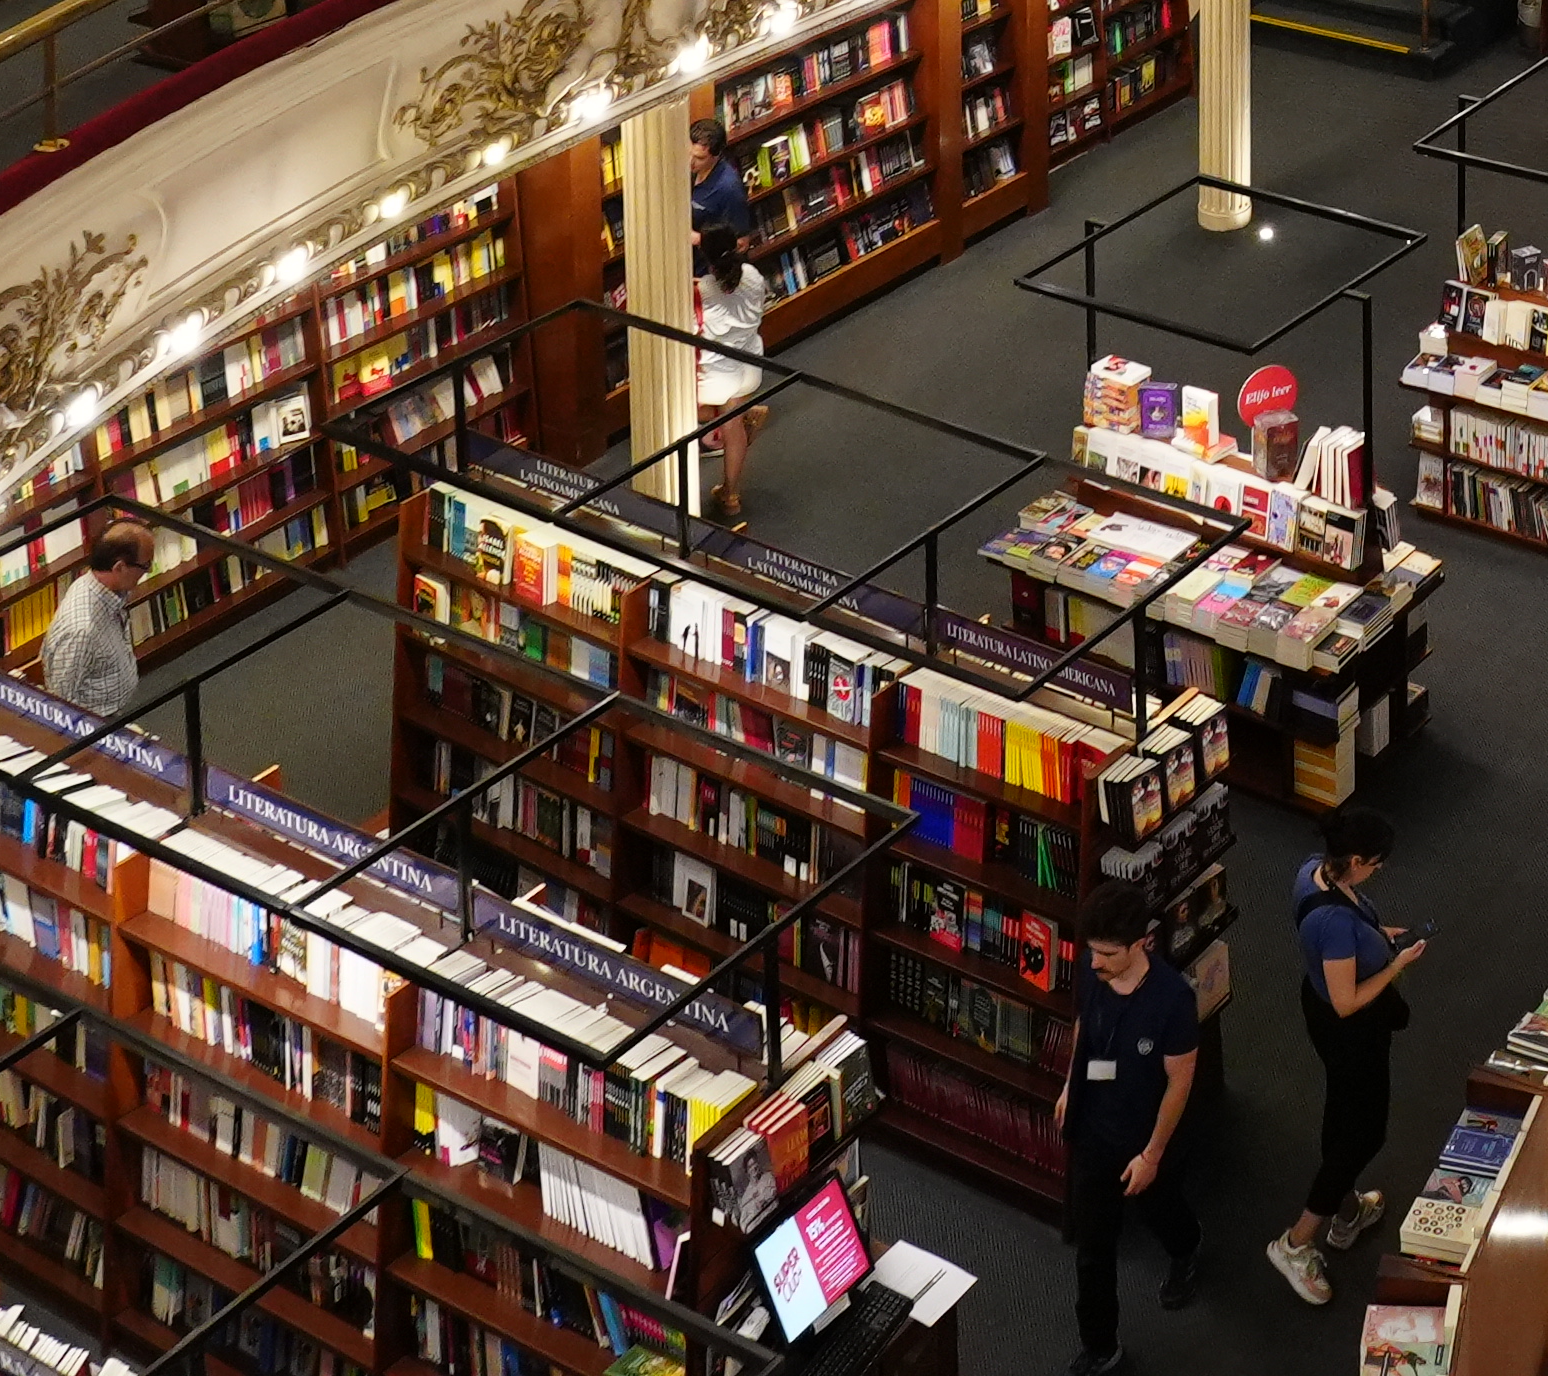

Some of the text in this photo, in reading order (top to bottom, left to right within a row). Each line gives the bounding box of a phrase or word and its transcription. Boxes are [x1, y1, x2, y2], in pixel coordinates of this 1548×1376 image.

[1244, 383, 1293, 406] Elijo leer
[765, 550, 838, 587] LITERATURA
[947, 622, 1116, 697] LITERATURA LATINOMERICANA
[228, 784, 330, 845] LITERATURA
[498, 912, 612, 981] LITERATURA
